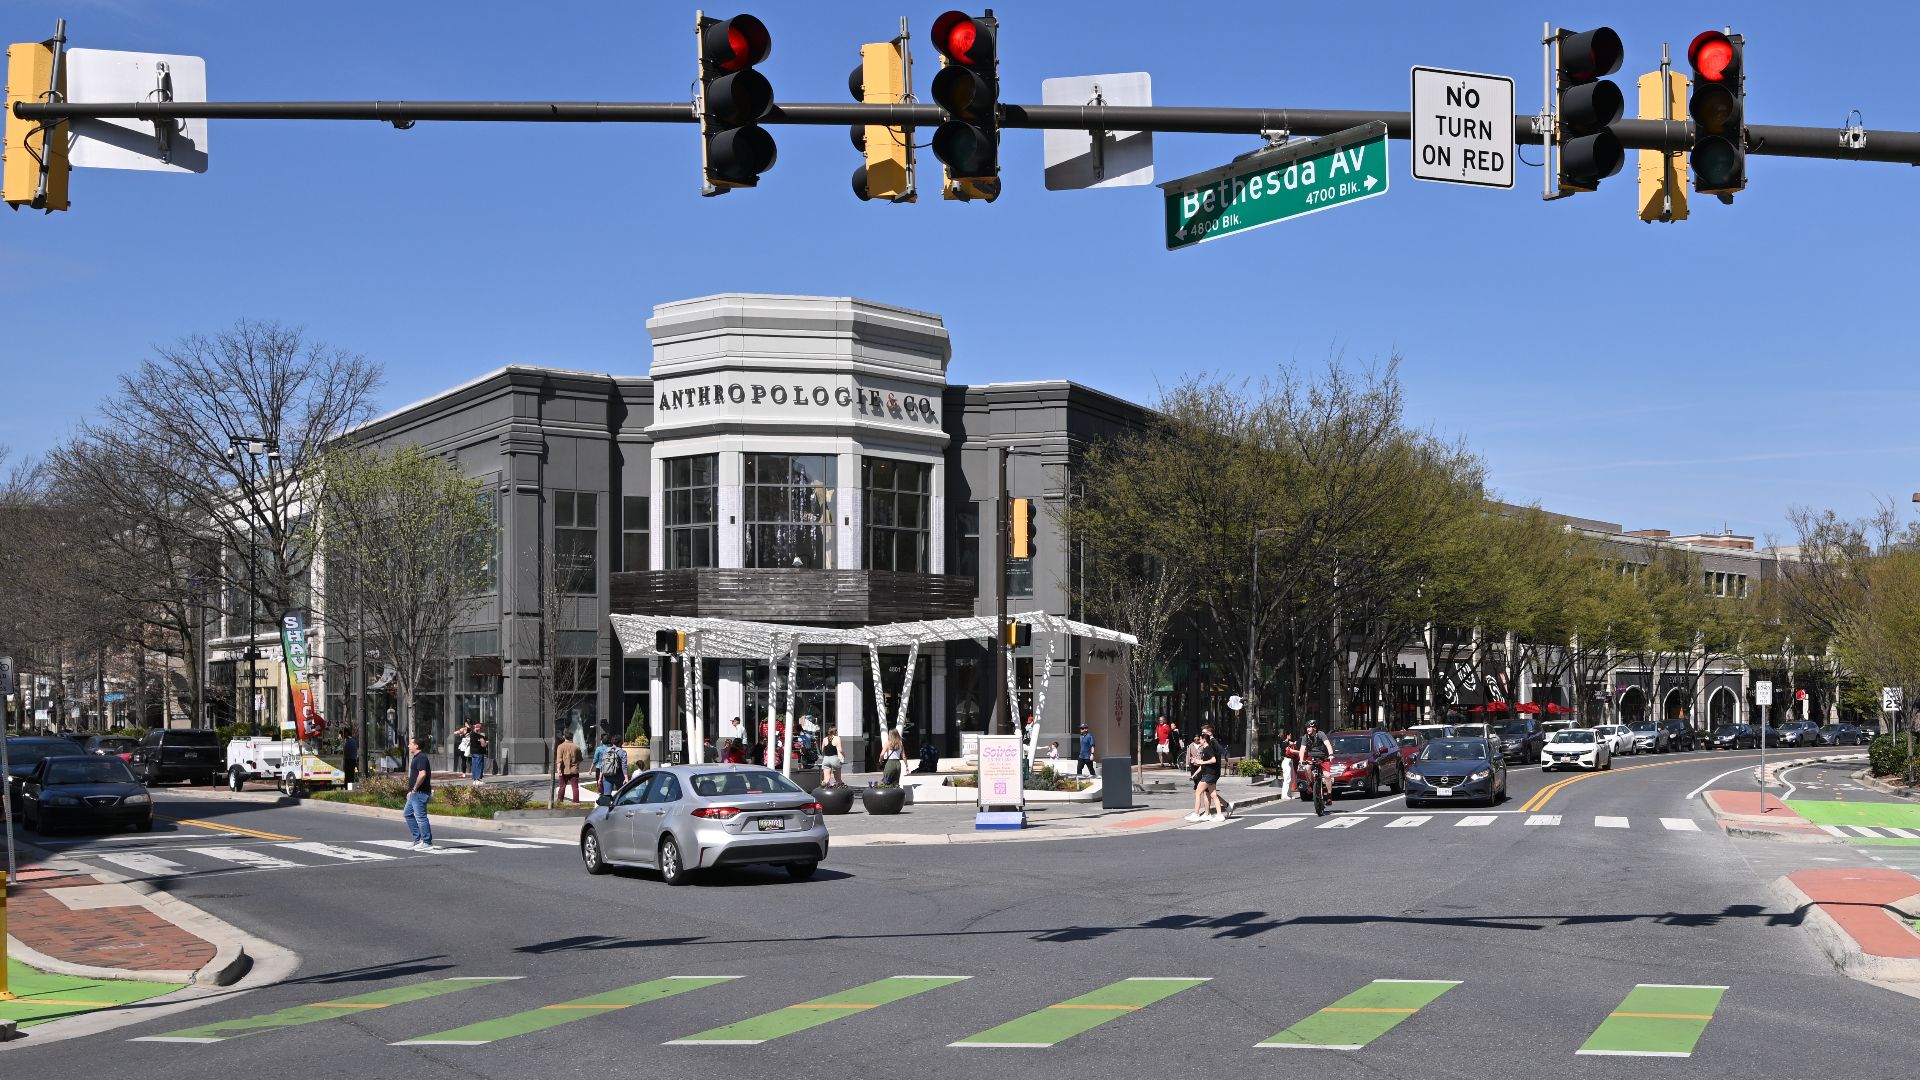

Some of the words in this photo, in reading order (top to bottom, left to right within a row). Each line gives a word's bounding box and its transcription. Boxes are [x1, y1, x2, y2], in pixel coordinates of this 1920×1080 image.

[1446, 85, 1480, 109] NO
[1435, 114, 1492, 141] TURN
[1422, 144, 1451, 167] ON
[1463, 148, 1504, 172] RED
[1183, 158, 1316, 219] Bethesda
[1305, 186, 1335, 205] 4700
[1340, 181, 1361, 197] Blk.
[1190, 218, 1219, 236] 4800
[1222, 213, 1242, 229] Blk.
[659, 383, 881, 411] ANTHROPOLOGIE
[886, 393, 897, 409] &
[904, 395, 936, 415] CO.
[283, 616, 307, 683] SHAVE
[300, 689, 321, 735] ICE
